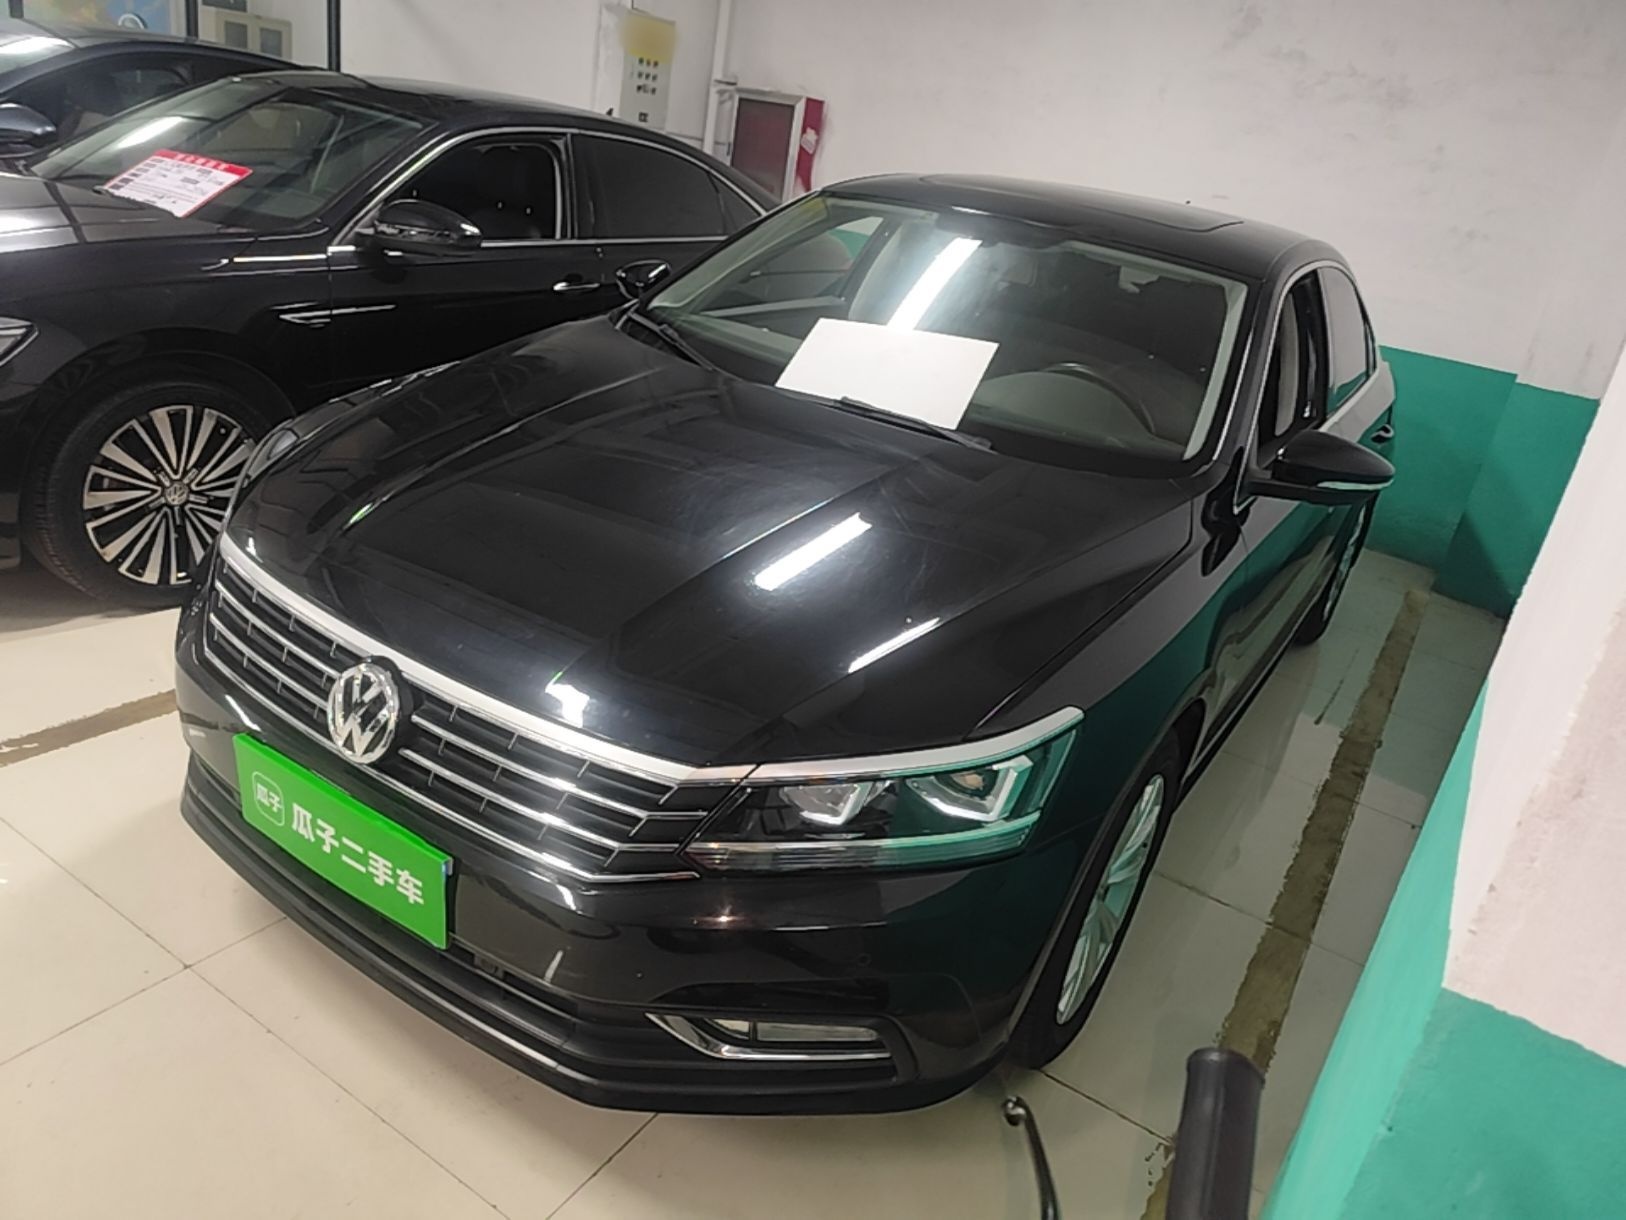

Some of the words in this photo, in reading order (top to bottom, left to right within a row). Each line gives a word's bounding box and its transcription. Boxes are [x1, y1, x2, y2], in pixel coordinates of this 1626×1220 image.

[328, 663, 399, 764] VW
[256, 783, 283, 813] 瓜子
[292, 803, 424, 905] 瓜子二手车
